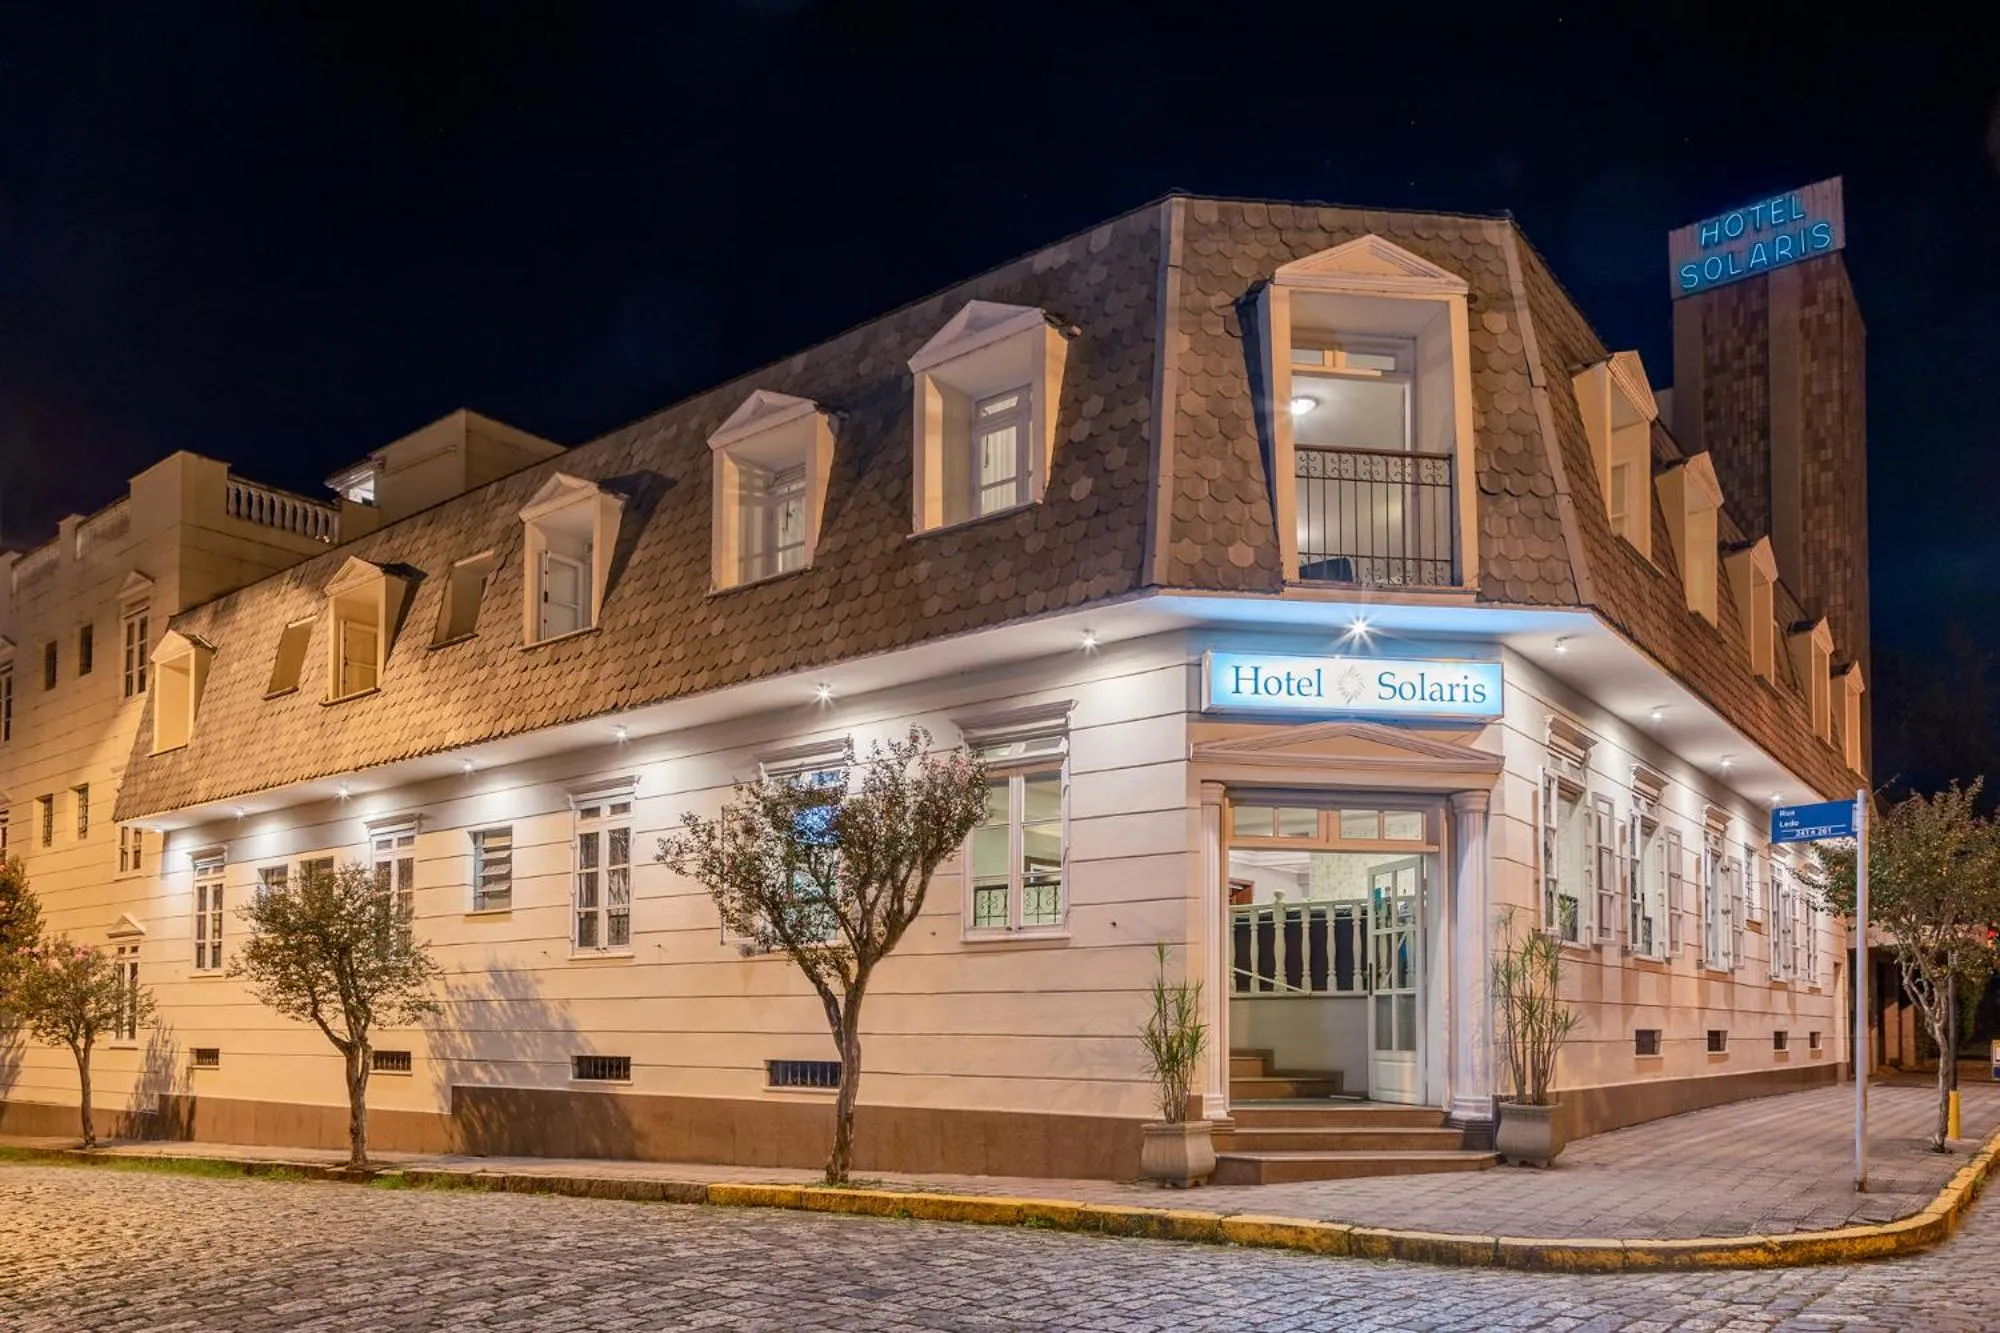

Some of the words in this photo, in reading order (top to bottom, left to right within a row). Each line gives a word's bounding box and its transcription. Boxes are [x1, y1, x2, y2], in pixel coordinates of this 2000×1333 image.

[1701, 195, 1805, 247] HOTEL
[1680, 222, 1832, 289] SOLARIS
[1231, 664, 1325, 698] Hotel
[1377, 670, 1487, 704] Solaris
